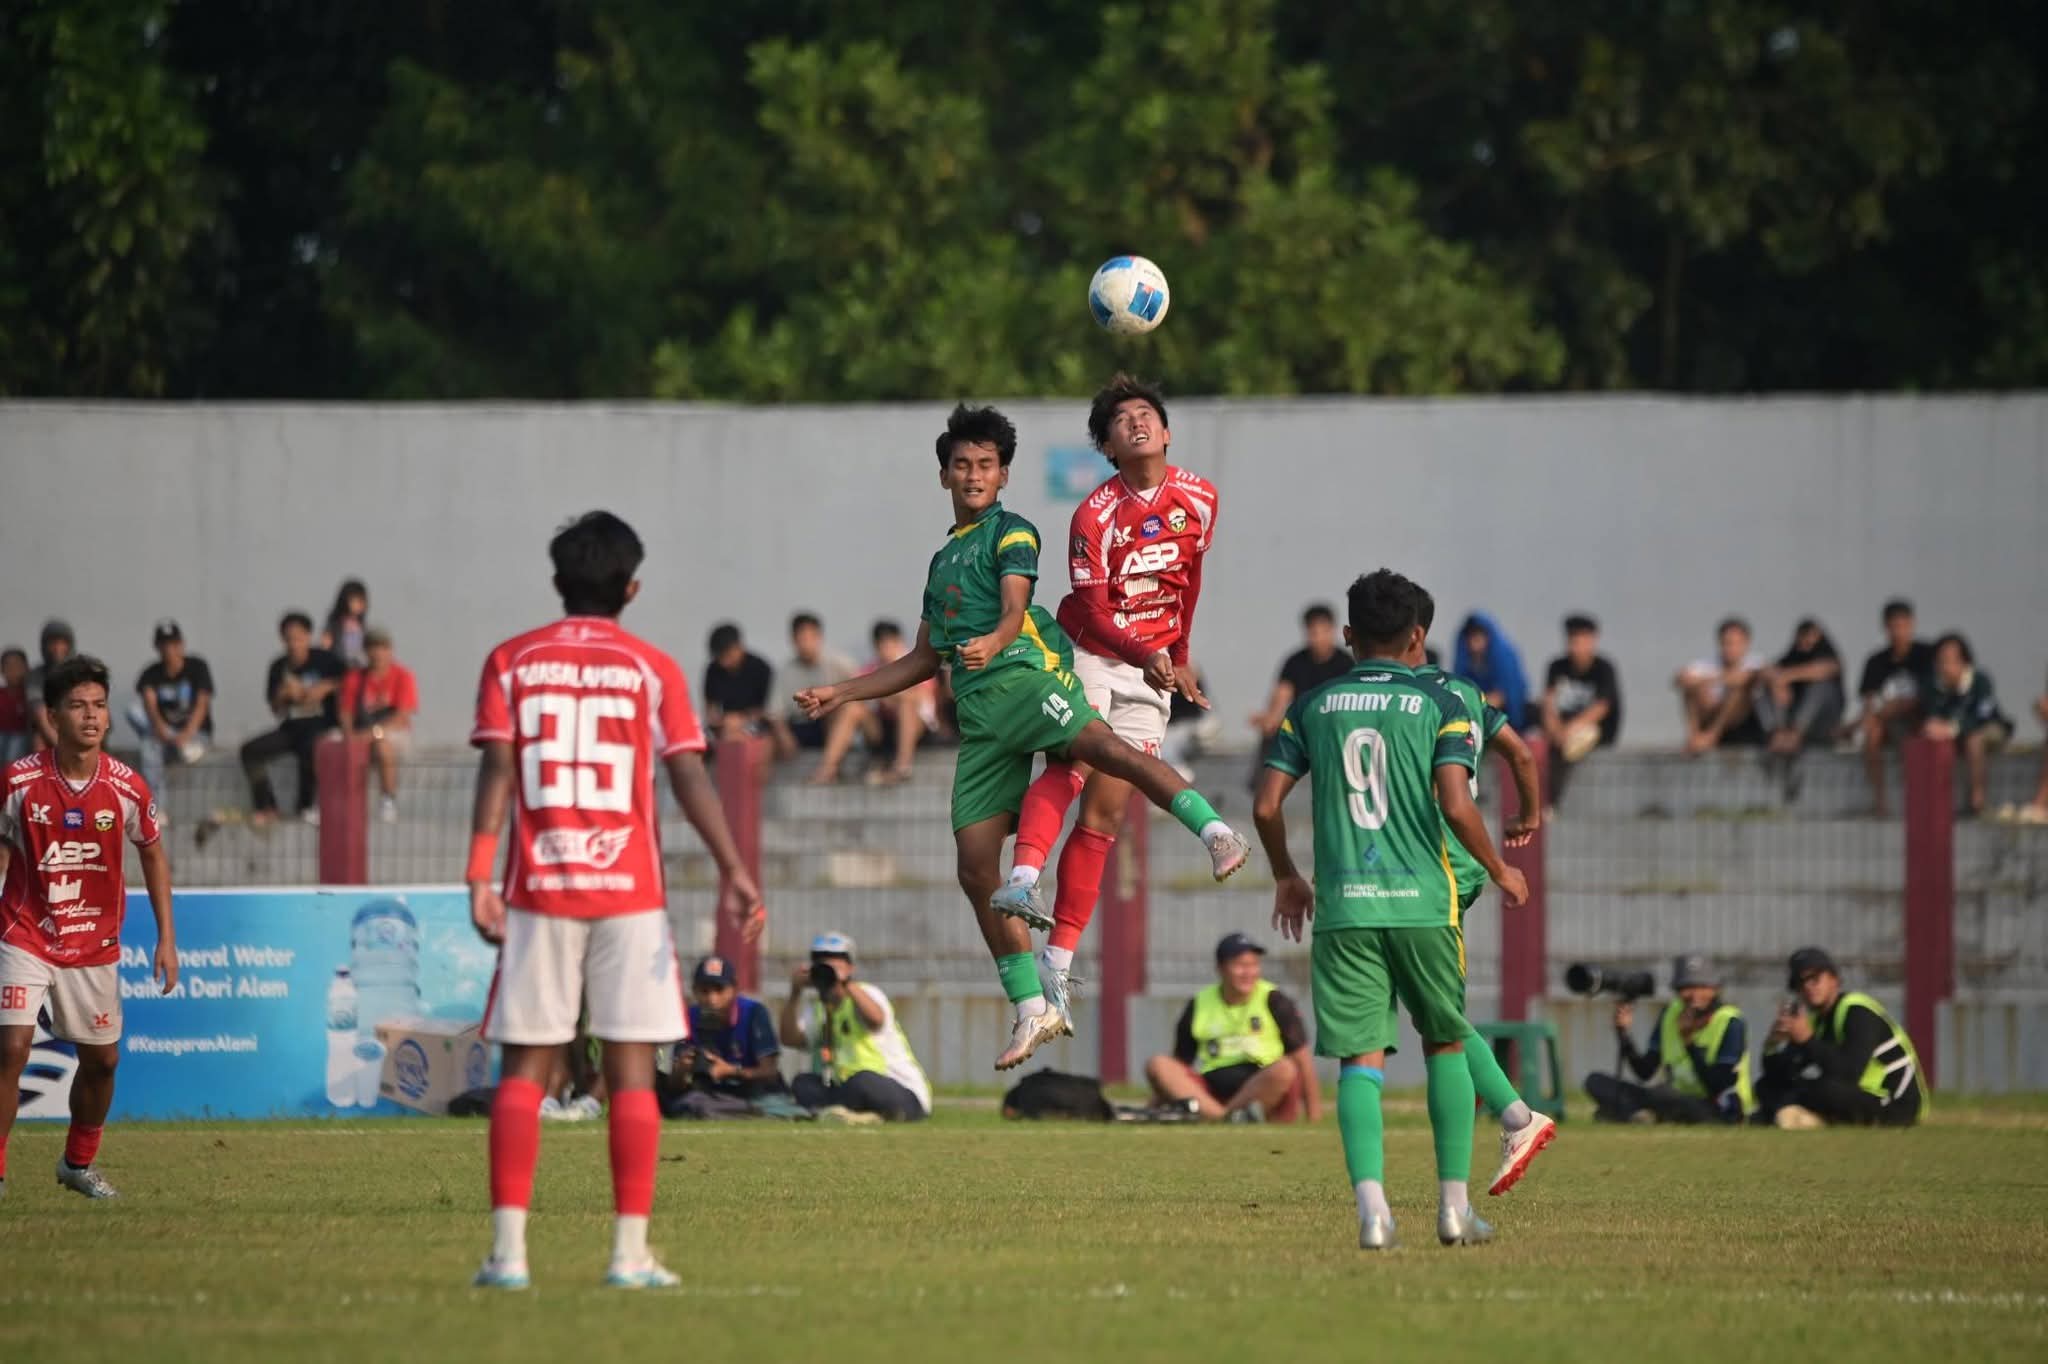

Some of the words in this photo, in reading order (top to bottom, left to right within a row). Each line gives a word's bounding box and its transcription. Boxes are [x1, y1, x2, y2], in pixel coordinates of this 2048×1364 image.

[1120, 541, 1180, 575] ABP
[1041, 692, 1069, 721] 14
[1320, 692, 1393, 714] JIMMY
[518, 692, 637, 815] 25
[1342, 727, 1389, 831] 9
[41, 840, 102, 866] ABP
[233, 944, 295, 967] Water
[1, 985, 28, 1010] 96
[189, 976, 232, 998] Dari
[237, 976, 289, 998] Alam
[127, 1034, 258, 1056] #KesegaranAlami
